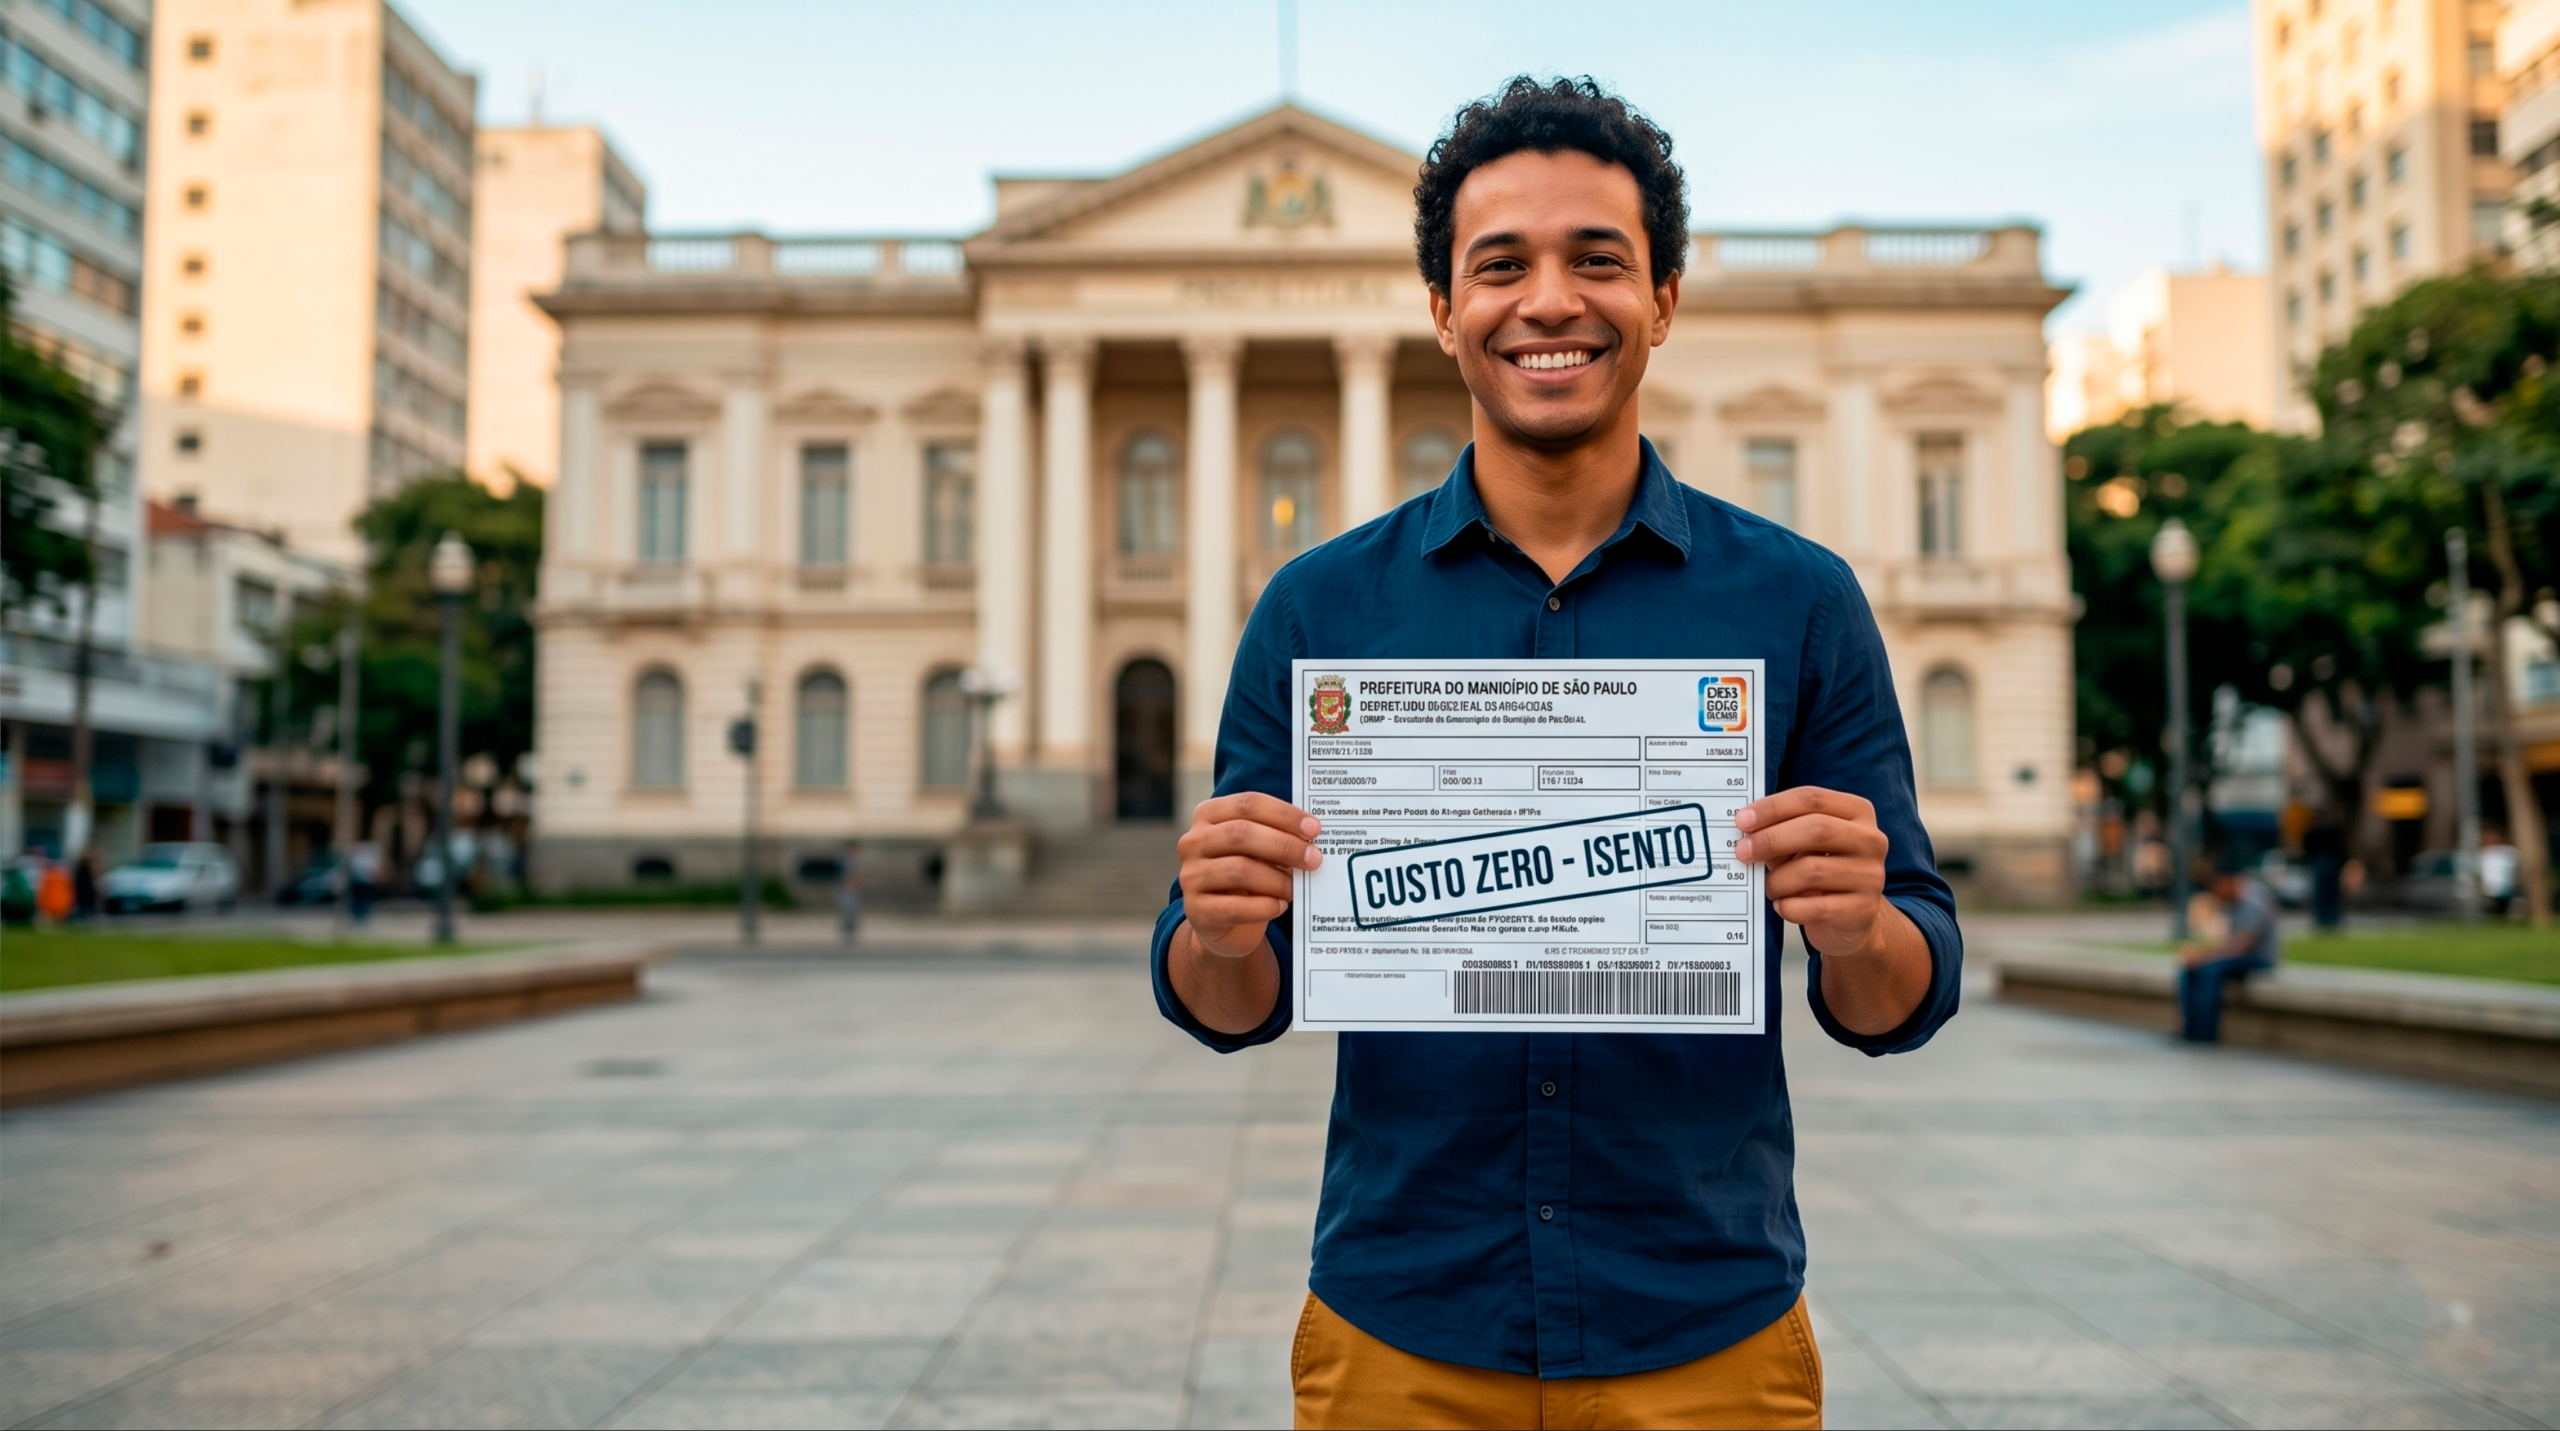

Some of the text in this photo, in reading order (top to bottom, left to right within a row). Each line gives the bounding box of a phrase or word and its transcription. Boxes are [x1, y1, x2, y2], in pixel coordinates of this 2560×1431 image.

[1445, 681, 1464, 696] DO
[1542, 681, 1560, 696] DE
[1563, 678, 1590, 696] SÃO
[1594, 681, 1638, 696] PAULO
[1365, 859, 1466, 909] CUSTO
[1472, 845, 1555, 895] ZERO
[1583, 824, 1696, 878] ISENTO
[1726, 872, 1745, 881] 0.50
[1726, 932, 1745, 941] 0.16
